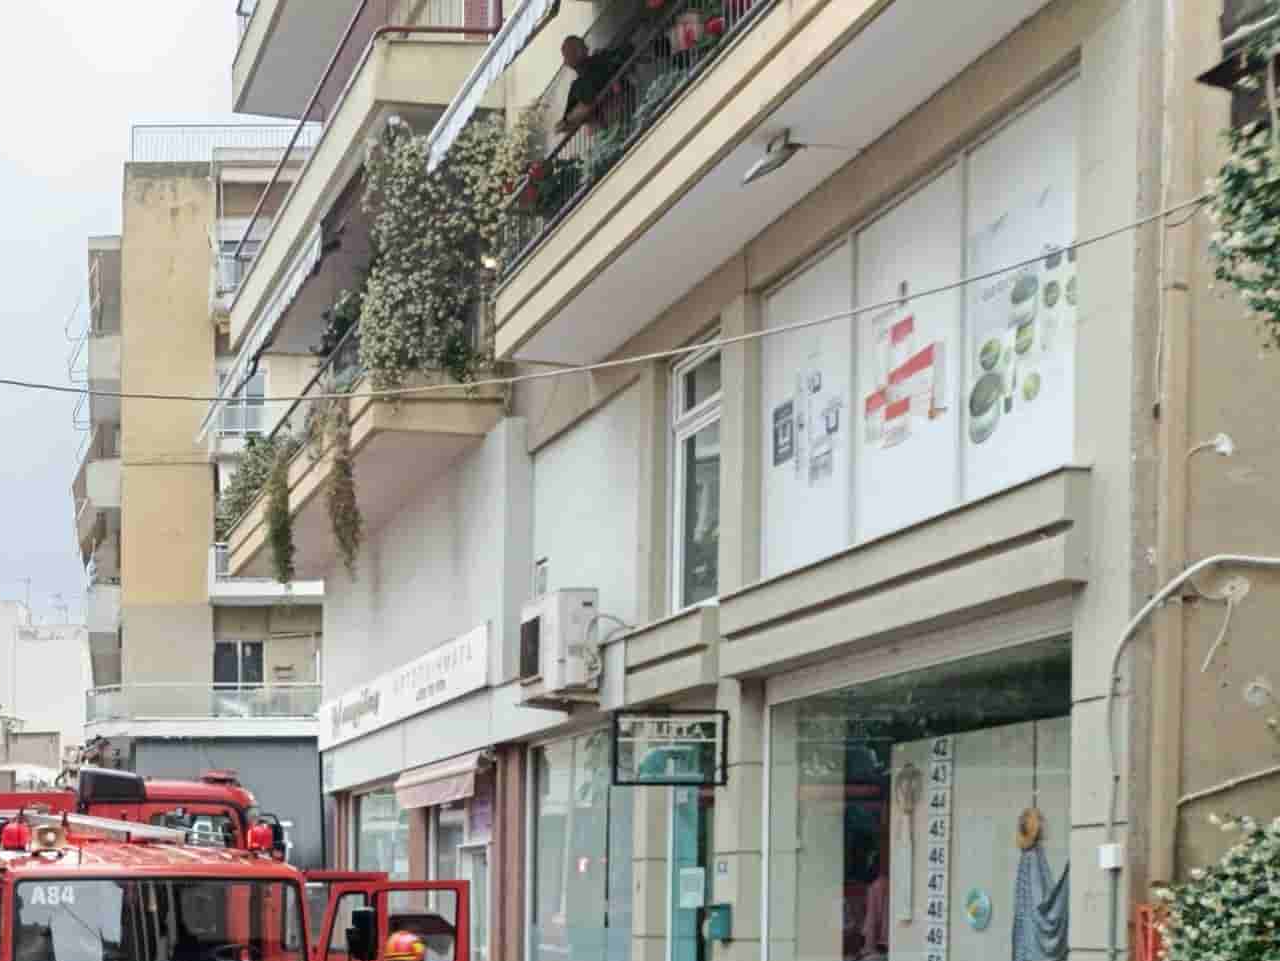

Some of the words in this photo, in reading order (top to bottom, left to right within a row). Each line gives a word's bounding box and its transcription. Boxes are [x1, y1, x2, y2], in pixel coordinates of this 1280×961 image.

[933, 738, 949, 756] 42
[930, 793, 945, 808] 44
[929, 820, 945, 837] 45
[928, 847, 945, 864] 46
[927, 874, 944, 891] 47
[30, 886, 75, 905] A84
[926, 928, 943, 945] 49
